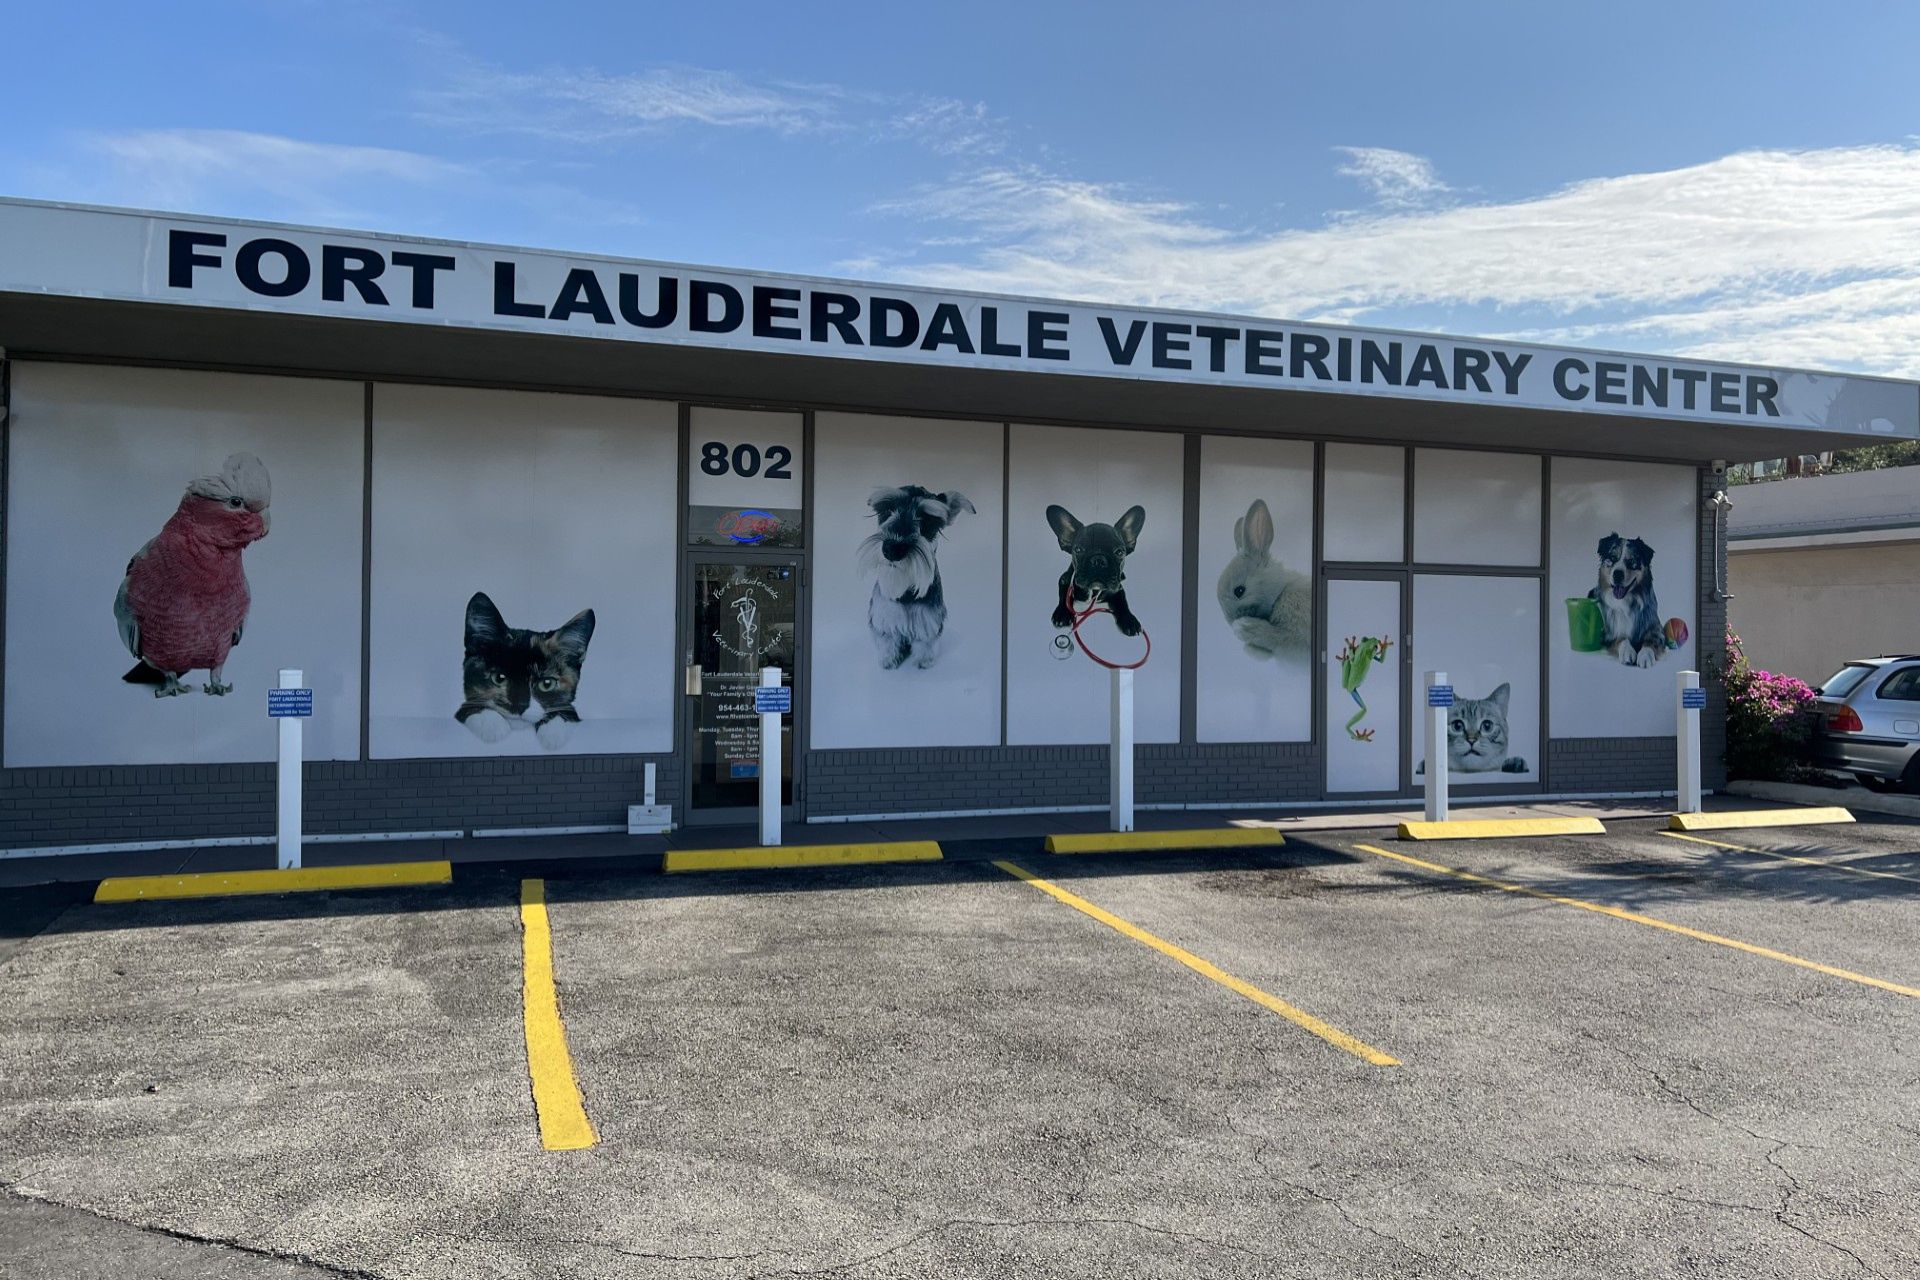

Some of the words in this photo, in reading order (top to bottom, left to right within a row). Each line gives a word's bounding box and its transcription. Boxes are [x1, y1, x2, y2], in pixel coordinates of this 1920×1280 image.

[168, 229, 456, 310] FORT
[493, 260, 1070, 361] LAUDERDALE
[1096, 316, 1533, 395] VETERINARY
[1552, 357, 1781, 417] CENTER
[700, 441, 792, 480] 802
[713, 582, 731, 600] Fort
[735, 577, 778, 600] Lauderdale
[712, 630, 754, 659] Veterinary
[758, 631, 782, 655] Center
